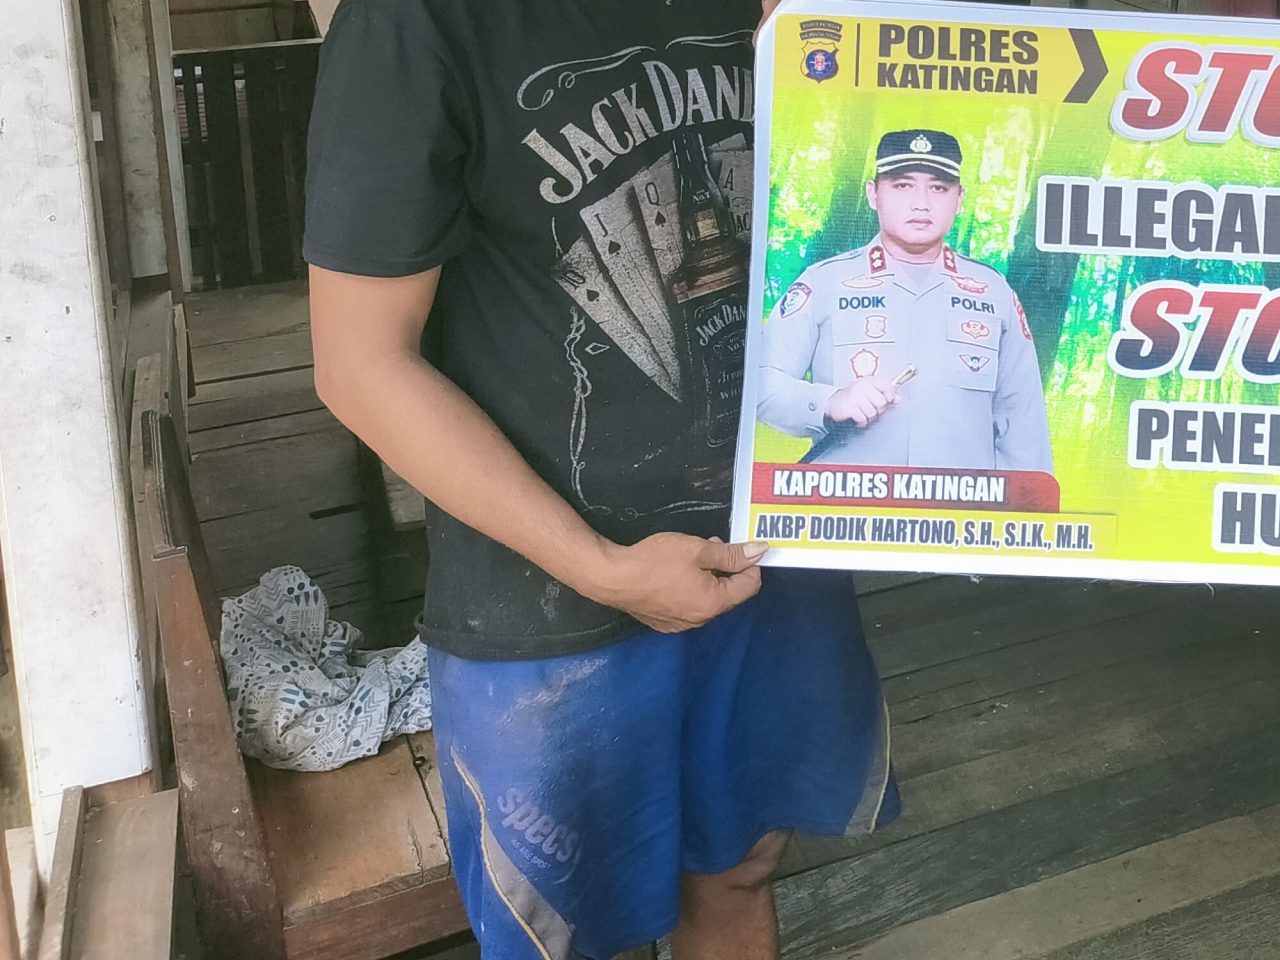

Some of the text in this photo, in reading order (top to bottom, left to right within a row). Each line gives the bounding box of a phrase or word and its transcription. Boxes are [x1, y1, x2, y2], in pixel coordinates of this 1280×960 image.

[878, 23, 1039, 65] POLRES
[876, 62, 1038, 96] KATINGAN
[520, 80, 660, 205] JACK
[644, 181, 662, 207] Q
[592, 212, 610, 238] J
[838, 294, 886, 317] DODIK
[950, 295, 995, 316] POLRI
[695, 312, 726, 347] JACK
[772, 469, 1006, 504] KAPOLRES KATINGAN
[754, 514, 1094, 551] AKBP DODIK HARTONO, S.H., S.I.K., M.H.
